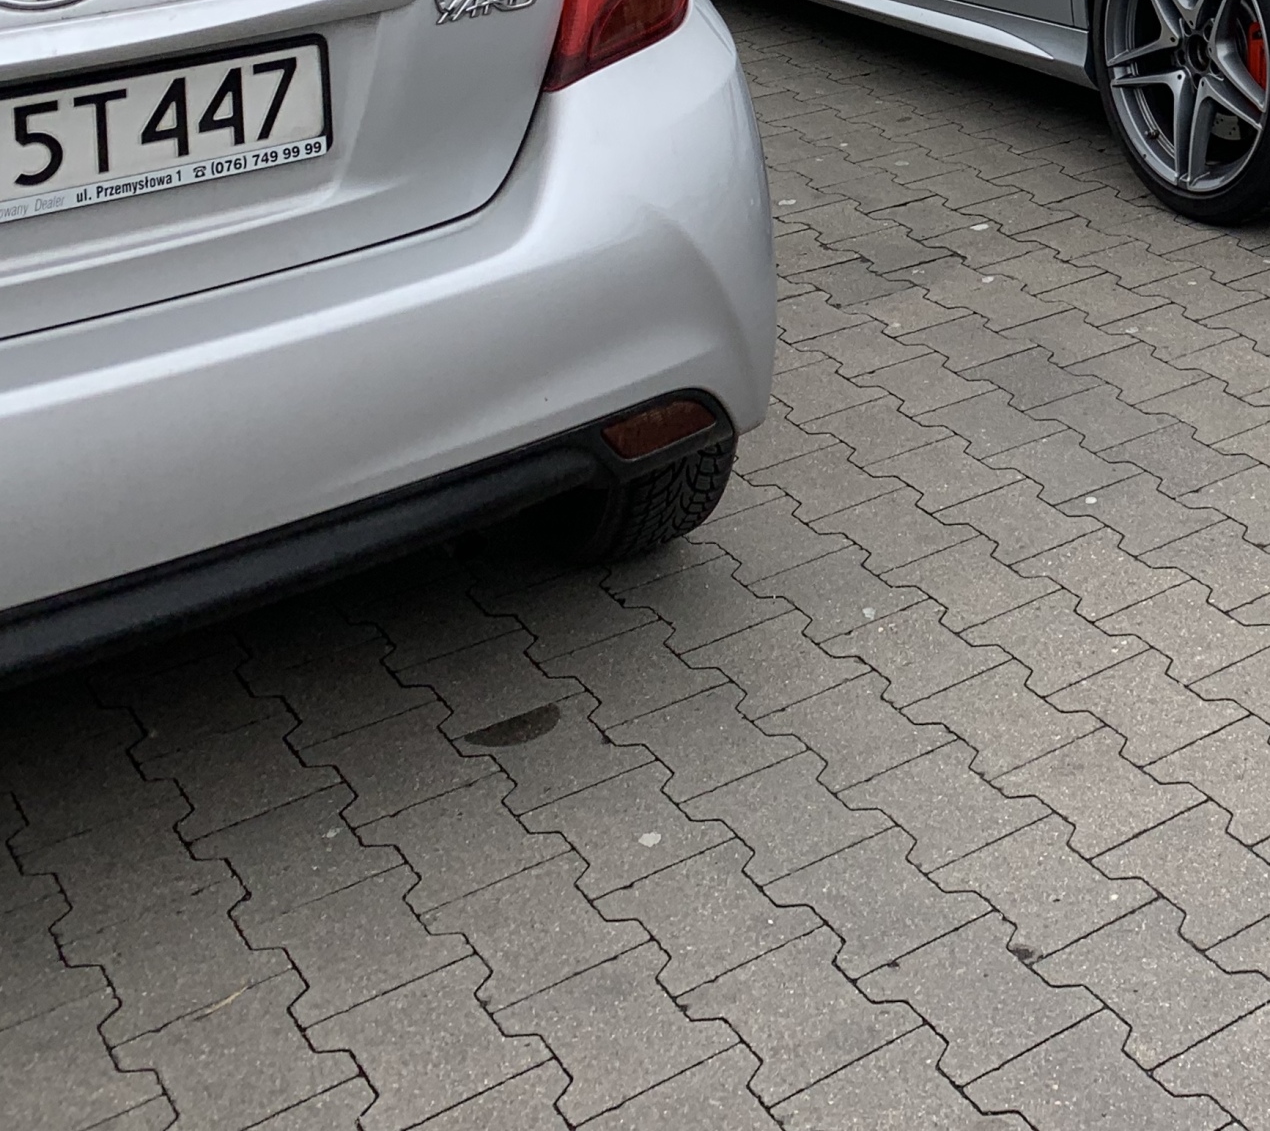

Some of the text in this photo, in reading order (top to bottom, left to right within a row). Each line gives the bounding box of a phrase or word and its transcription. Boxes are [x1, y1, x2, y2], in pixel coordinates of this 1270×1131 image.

[13, 57, 298, 187] 5T447
[34, 196, 65, 212] Dealer
[76, 187, 92, 203] ul.
[96, 172, 173, 200] Przemysłowa
[176, 170, 183, 183] 1
[211, 155, 248, 176] (076)
[252, 150, 278, 167] 749
[282, 145, 301, 160] 99
[304, 141, 323, 156] 99
